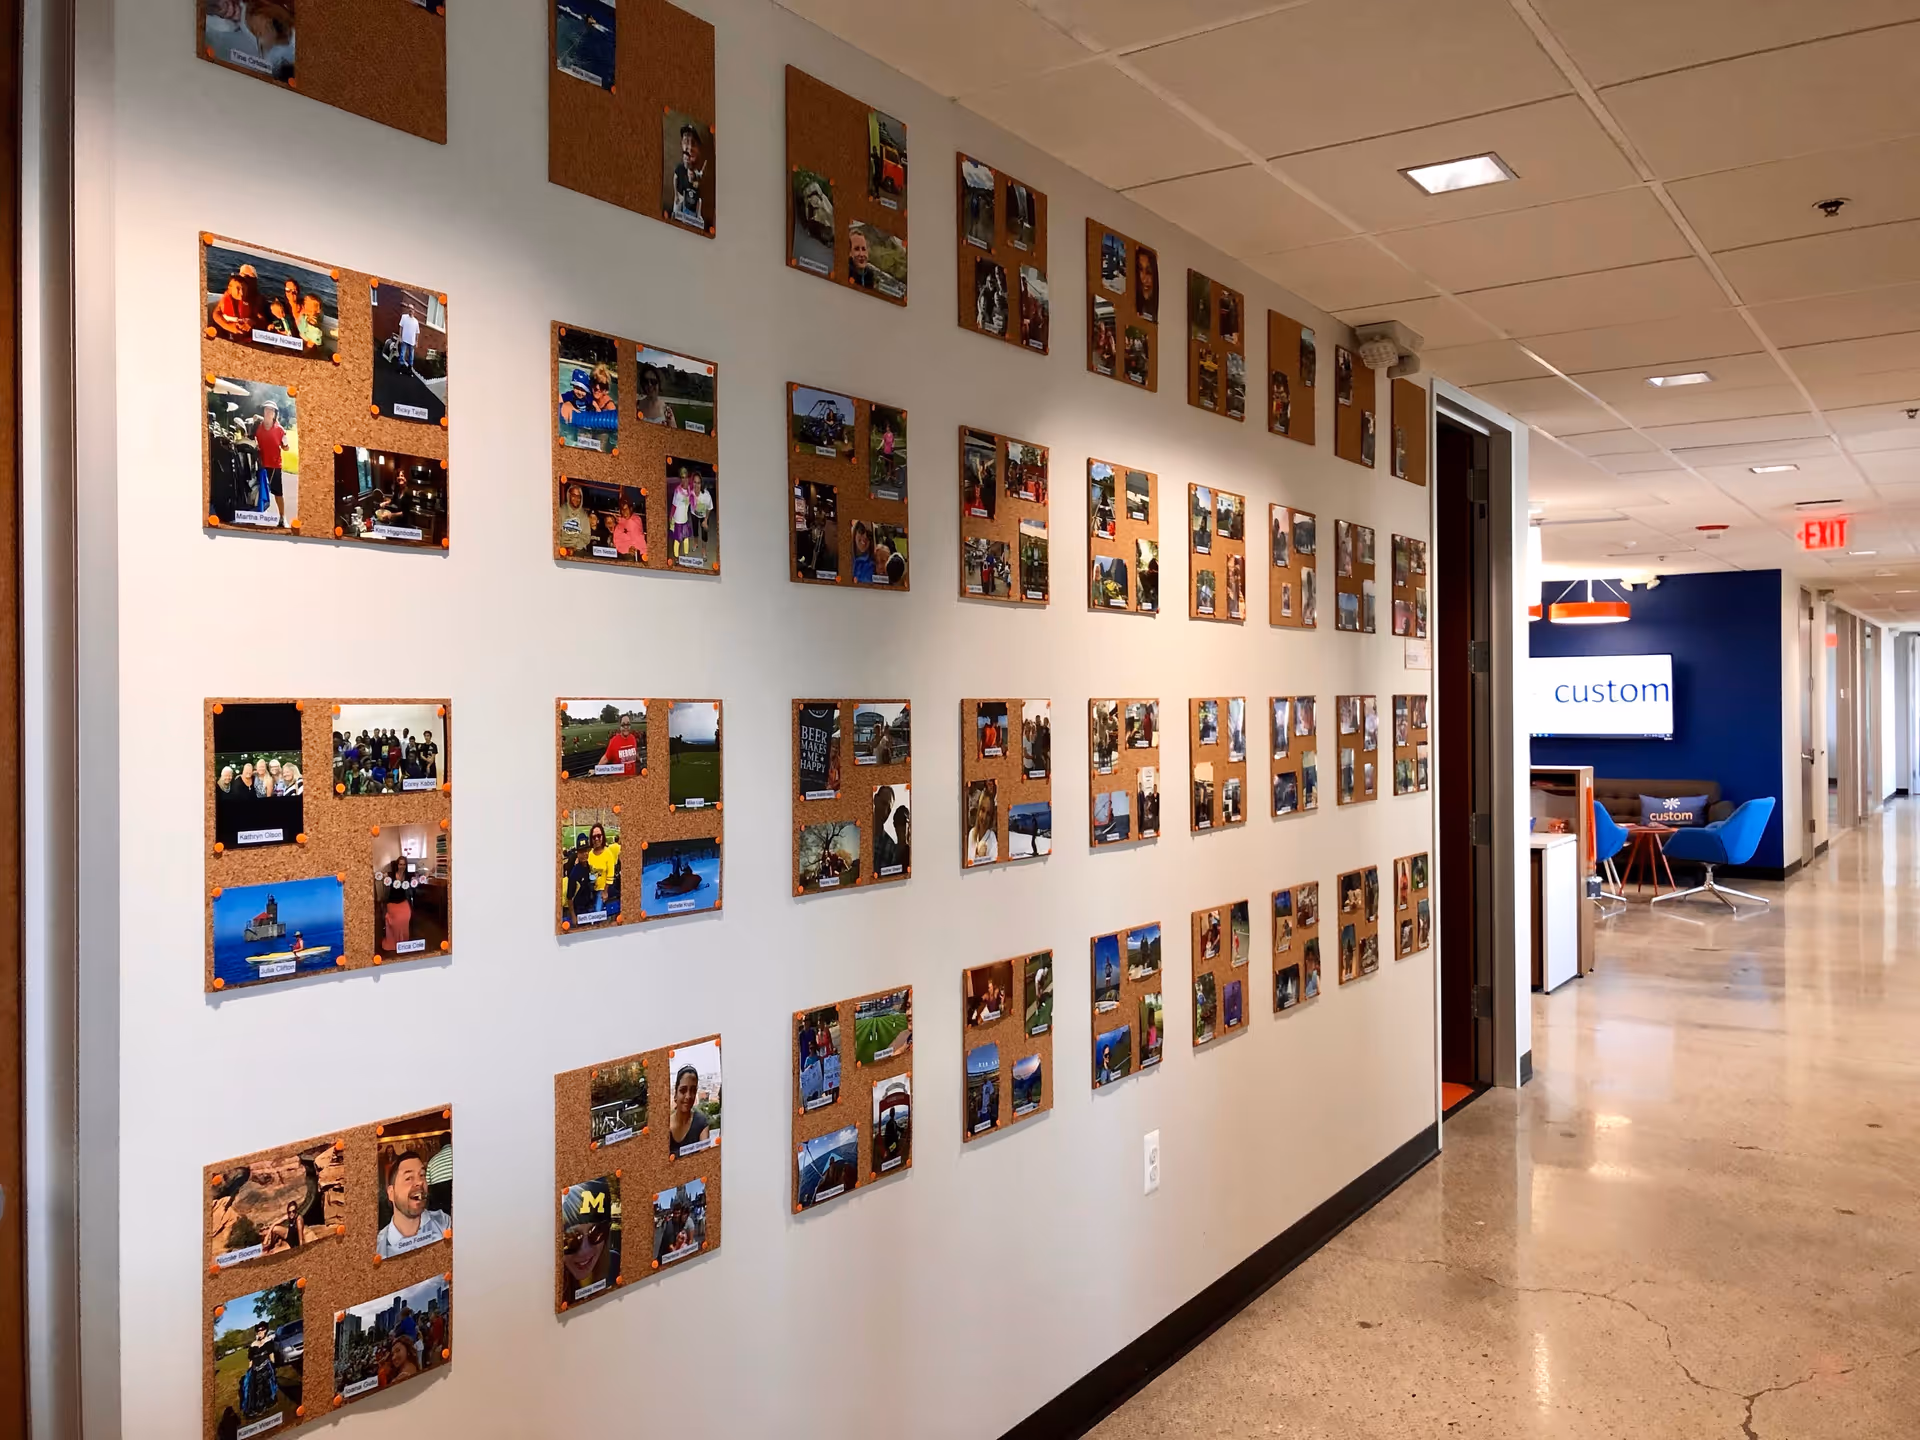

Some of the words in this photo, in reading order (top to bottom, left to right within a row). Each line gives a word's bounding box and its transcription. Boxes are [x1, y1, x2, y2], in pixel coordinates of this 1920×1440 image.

[254, 331, 278, 343] Lindsay
[396, 405, 410, 415] Ricky
[412, 408, 427, 417] Taylor
[259, 514, 278, 522] Papke
[387, 528, 421, 538] Higginbottom
[1805, 519, 1847, 549] EXIT
[1555, 680, 1669, 703] custom
[801, 725, 828, 744] BEER
[801, 739, 827, 755] MAKES
[807, 751, 820, 762] ME
[800, 759, 826, 773] HAPPY
[1649, 811, 1693, 821] custom
[239, 833, 263, 842] Kathryn
[398, 943, 411, 951] Erica
[260, 967, 275, 975] Julia
[275, 964, 295, 973] Clifton
[579, 1190, 605, 1214] M
[398, 1240, 413, 1249] Sean
[413, 1233, 432, 1243] Fossee
[217, 1254, 237, 1264] Nicole
[345, 1383, 362, 1394] Ioana
[238, 1425, 258, 1437] Karen
